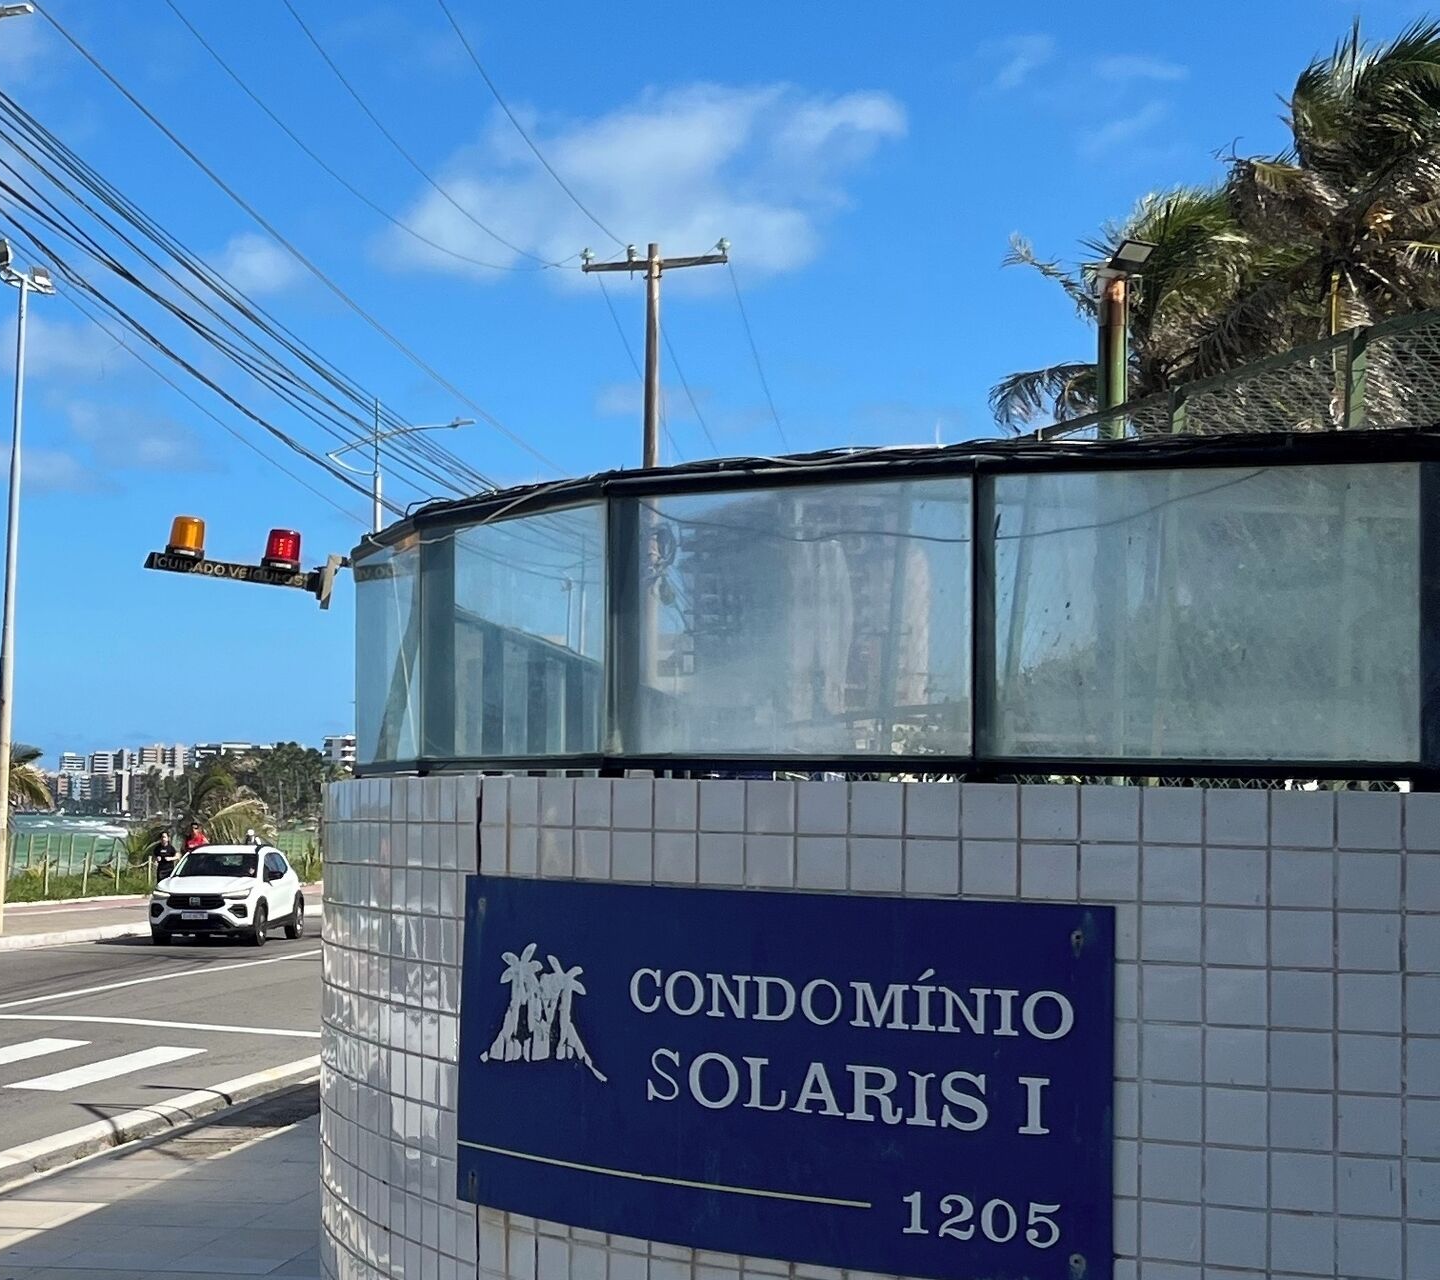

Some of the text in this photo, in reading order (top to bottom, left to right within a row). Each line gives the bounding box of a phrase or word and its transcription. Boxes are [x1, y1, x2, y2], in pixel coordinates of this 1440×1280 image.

[629, 967, 1075, 1041] CONDOMÍNIO
[647, 1047, 1051, 1136] SOLARIS I
[902, 1190, 1062, 1249] 1205
